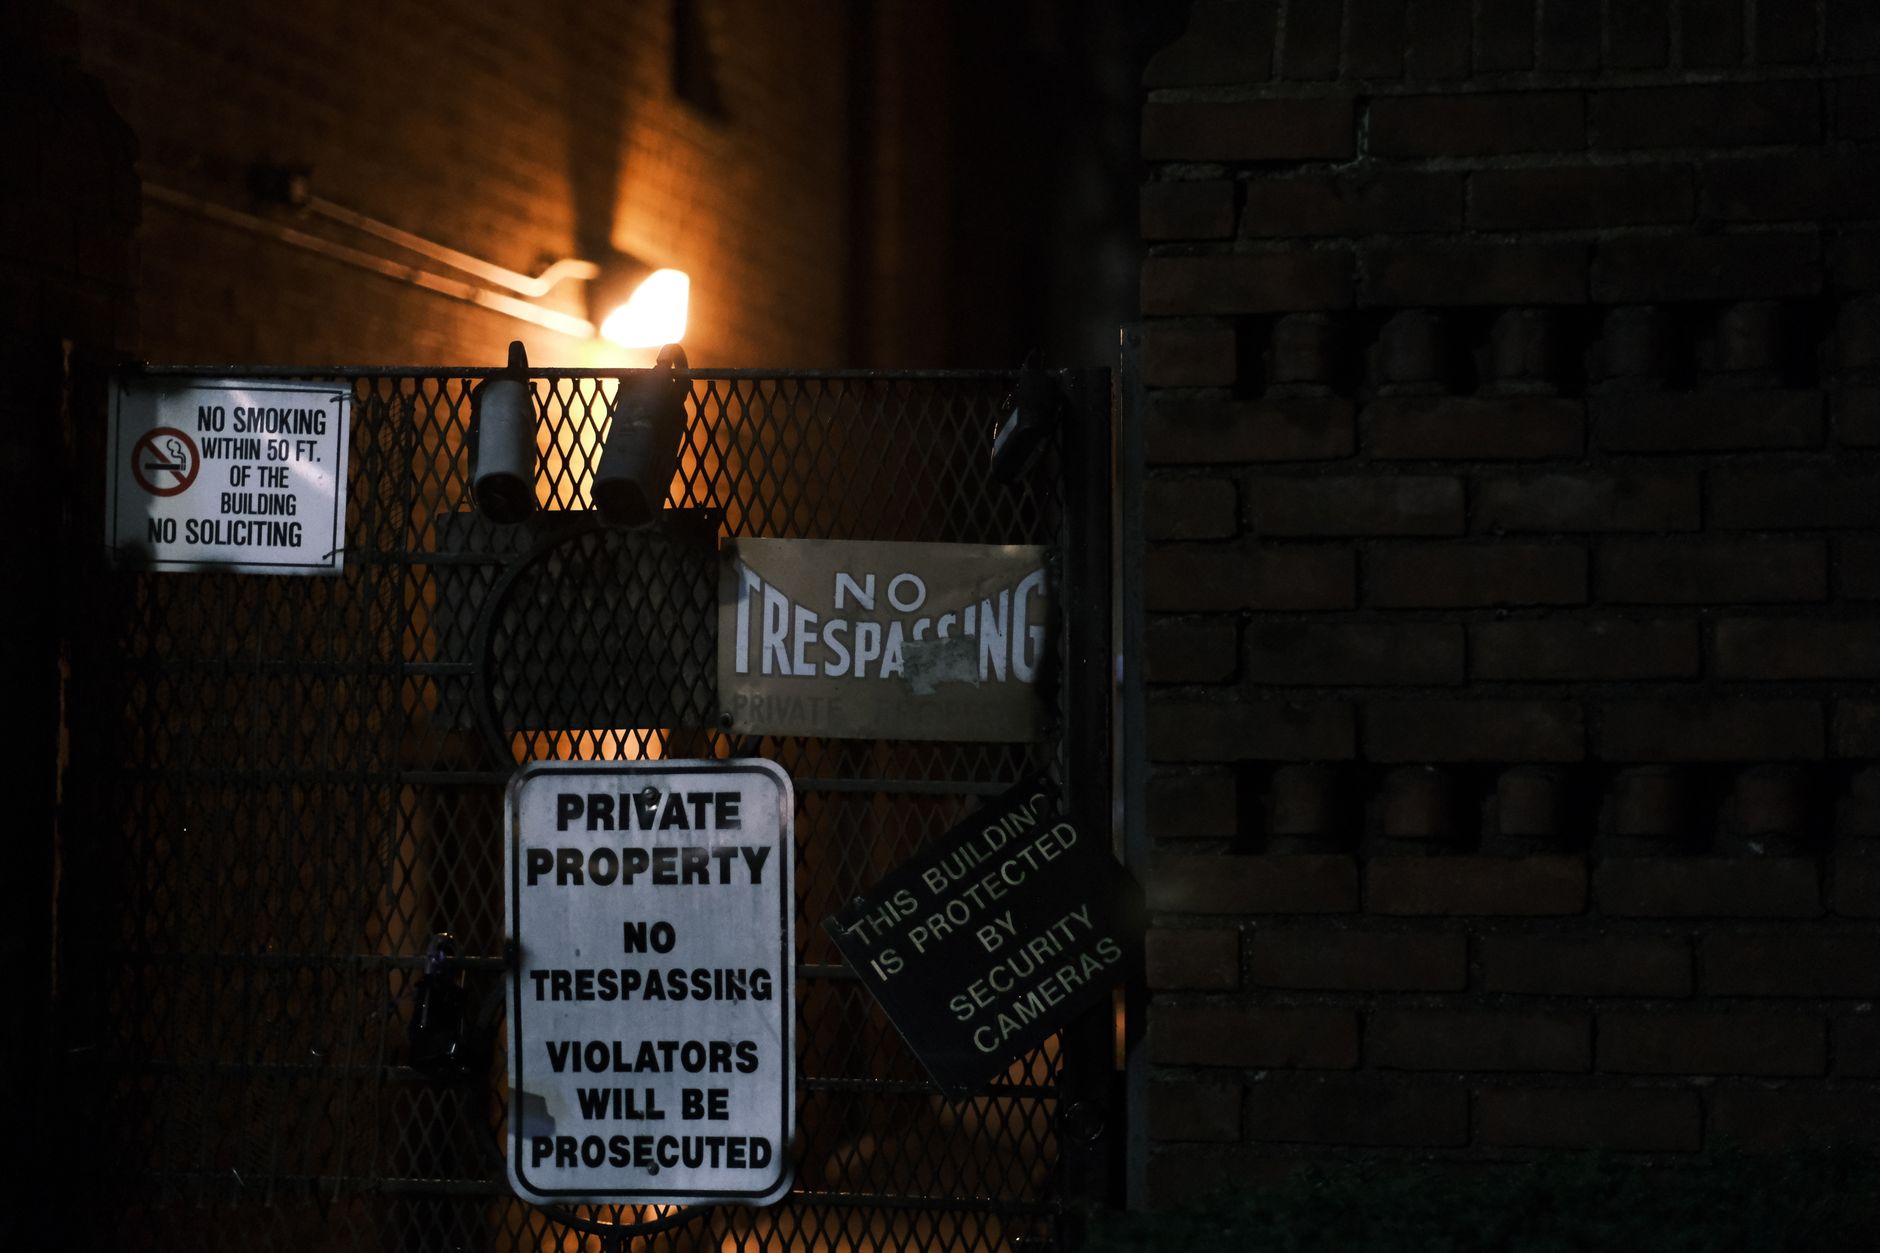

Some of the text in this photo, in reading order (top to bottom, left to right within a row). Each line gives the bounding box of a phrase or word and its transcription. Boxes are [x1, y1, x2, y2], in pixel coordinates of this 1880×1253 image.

[198, 406, 326, 435] NO SMOKING
[202, 437, 321, 462] WITHIN 50 FT.
[230, 465, 289, 488] OF THE
[221, 492, 296, 515] BUILDING
[148, 518, 302, 547] NO SOLICITING
[835, 572, 927, 613] NO
[557, 793, 741, 831] PRIVATE
[527, 847, 771, 886] PROPERTY
[848, 888, 919, 946] THIS
[870, 822, 1078, 982] IS PROTECTED
[624, 921, 676, 953] NO
[976, 910, 1017, 954] BY
[949, 903, 1096, 1022] SECURITY
[530, 969, 772, 1001] TRESPASSING
[973, 936, 1123, 1053] CAMERAS
[546, 1040, 759, 1073] VIOLATORS
[577, 1088, 729, 1120] WILL BE
[531, 1136, 772, 1168] PROSECUTED
